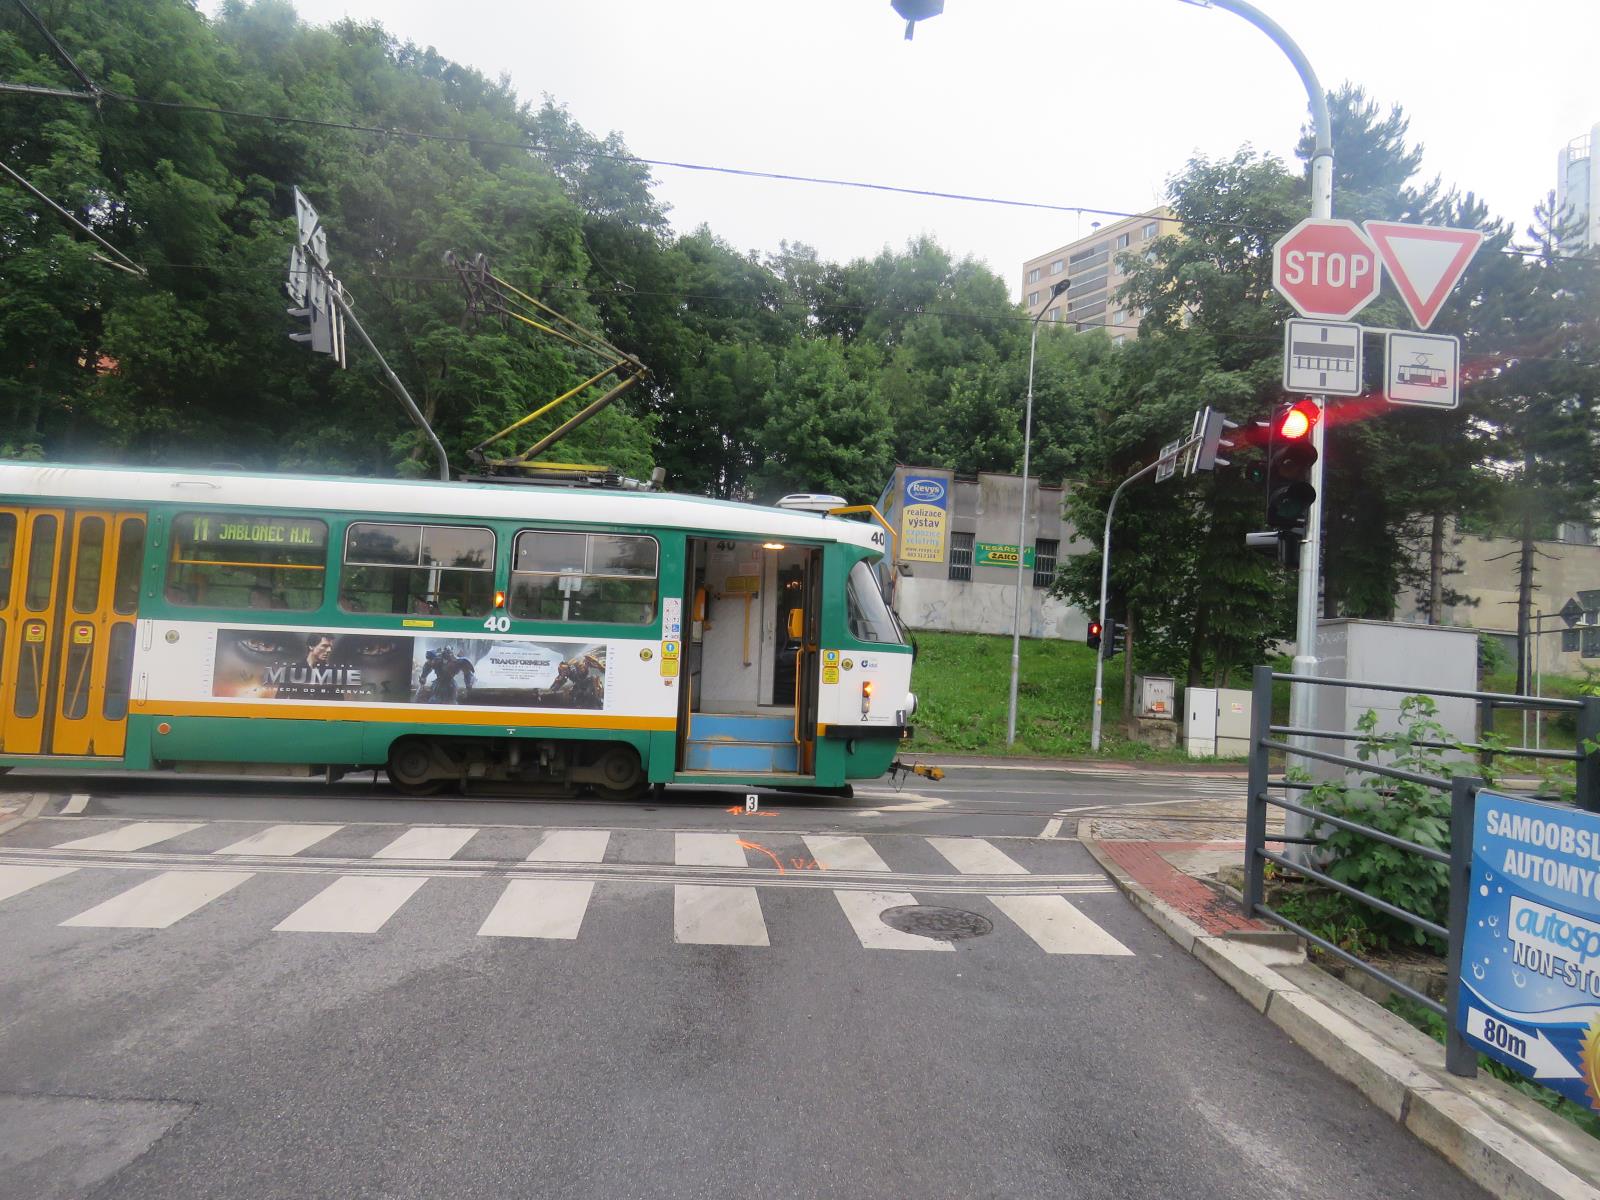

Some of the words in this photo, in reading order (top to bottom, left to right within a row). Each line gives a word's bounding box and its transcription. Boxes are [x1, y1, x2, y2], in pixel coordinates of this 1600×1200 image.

[1285, 250, 1369, 289] STOP
[913, 484, 940, 495] Revys
[907, 508, 942, 518] realizace
[192, 516, 209, 542] 11
[219, 523, 286, 542] JABLONEC
[908, 518, 940, 529] výstav
[871, 532, 885, 546] 40
[483, 616, 511, 632] 40
[490, 657, 550, 667] TRANSFORMERS
[263, 667, 362, 686] MUMIE
[748, 796, 756, 810] 3
[1483, 1018, 1527, 1060] 80m
